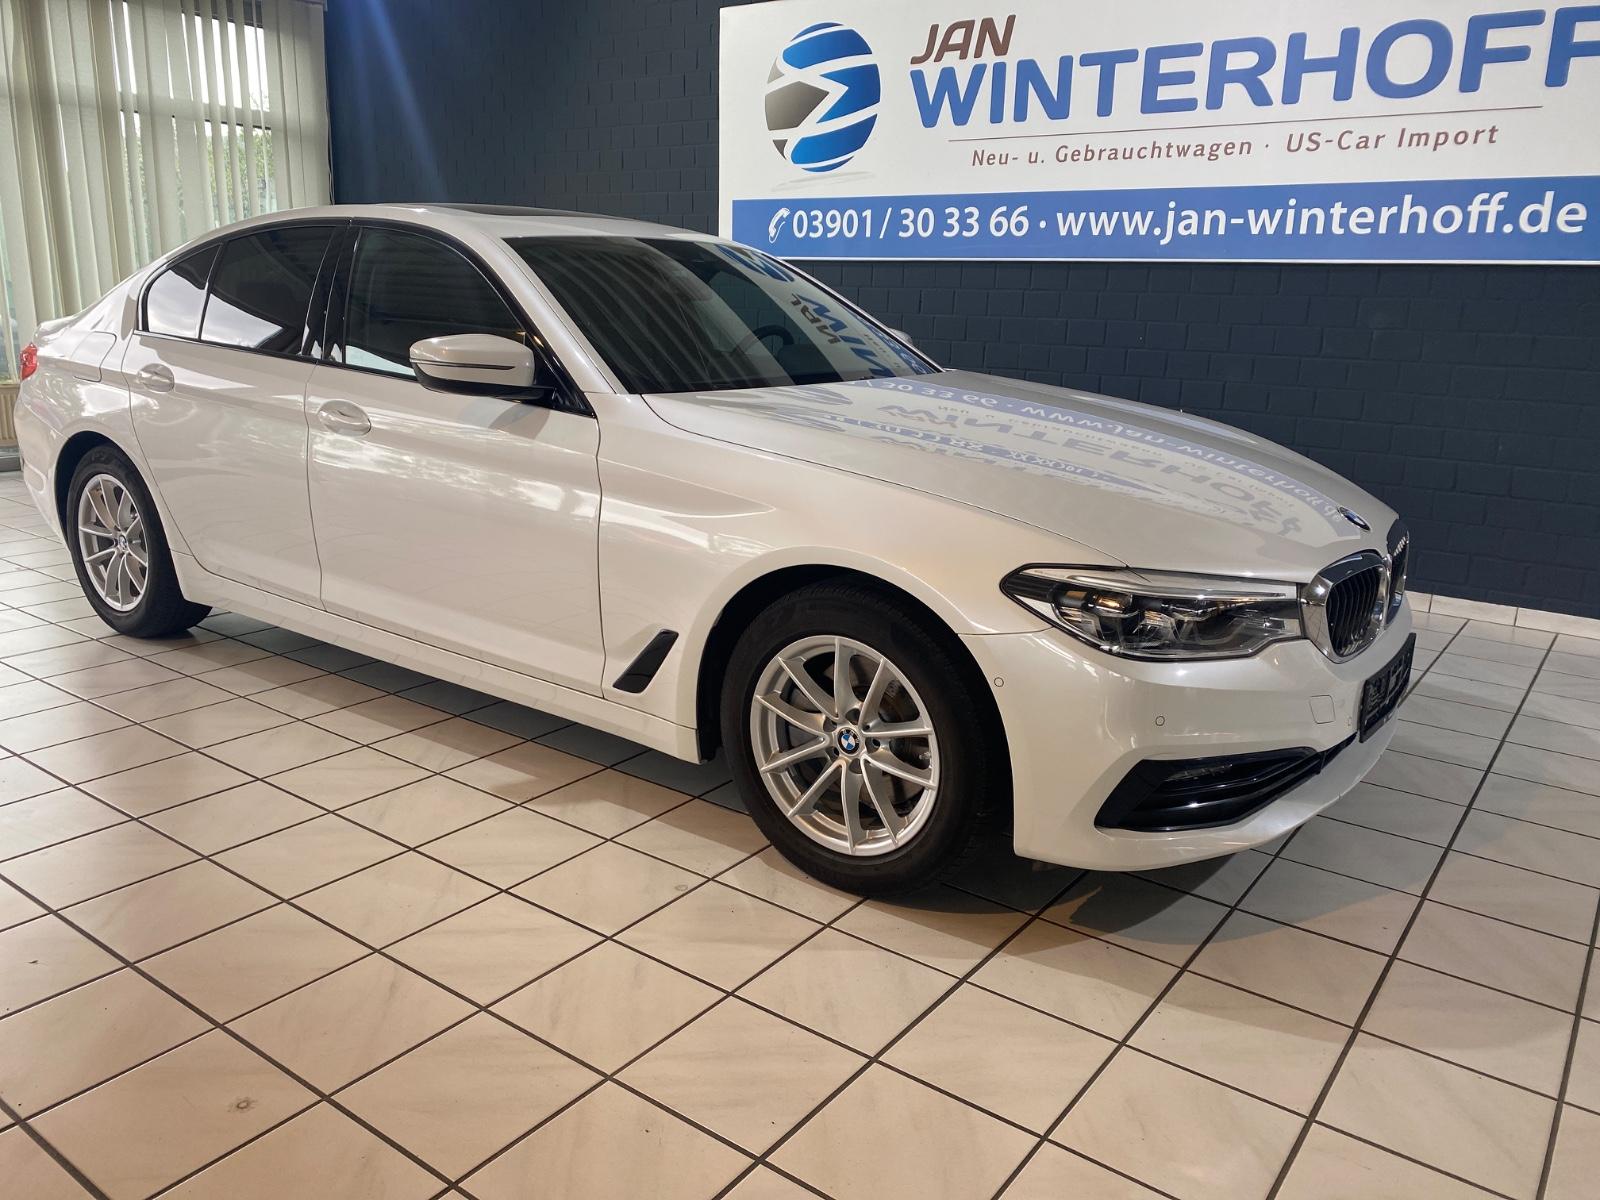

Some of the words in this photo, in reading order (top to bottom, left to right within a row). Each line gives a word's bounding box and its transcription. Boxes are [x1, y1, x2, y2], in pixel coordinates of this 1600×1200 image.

[910, 14, 1017, 65] JAN
[911, 7, 1600, 129] WINTERHOFF
[972, 149, 1019, 167] Neu-
[1028, 151, 1046, 165] u.
[1055, 141, 1252, 163] Gebrauchtwagen
[1286, 130, 1386, 153] US-Car
[1397, 125, 1499, 152] Import
[898, 208, 935, 238] 30
[943, 207, 980, 237] 33
[989, 205, 1029, 237] 66
[1056, 190, 1587, 246] www.jan-winterhoff.de
